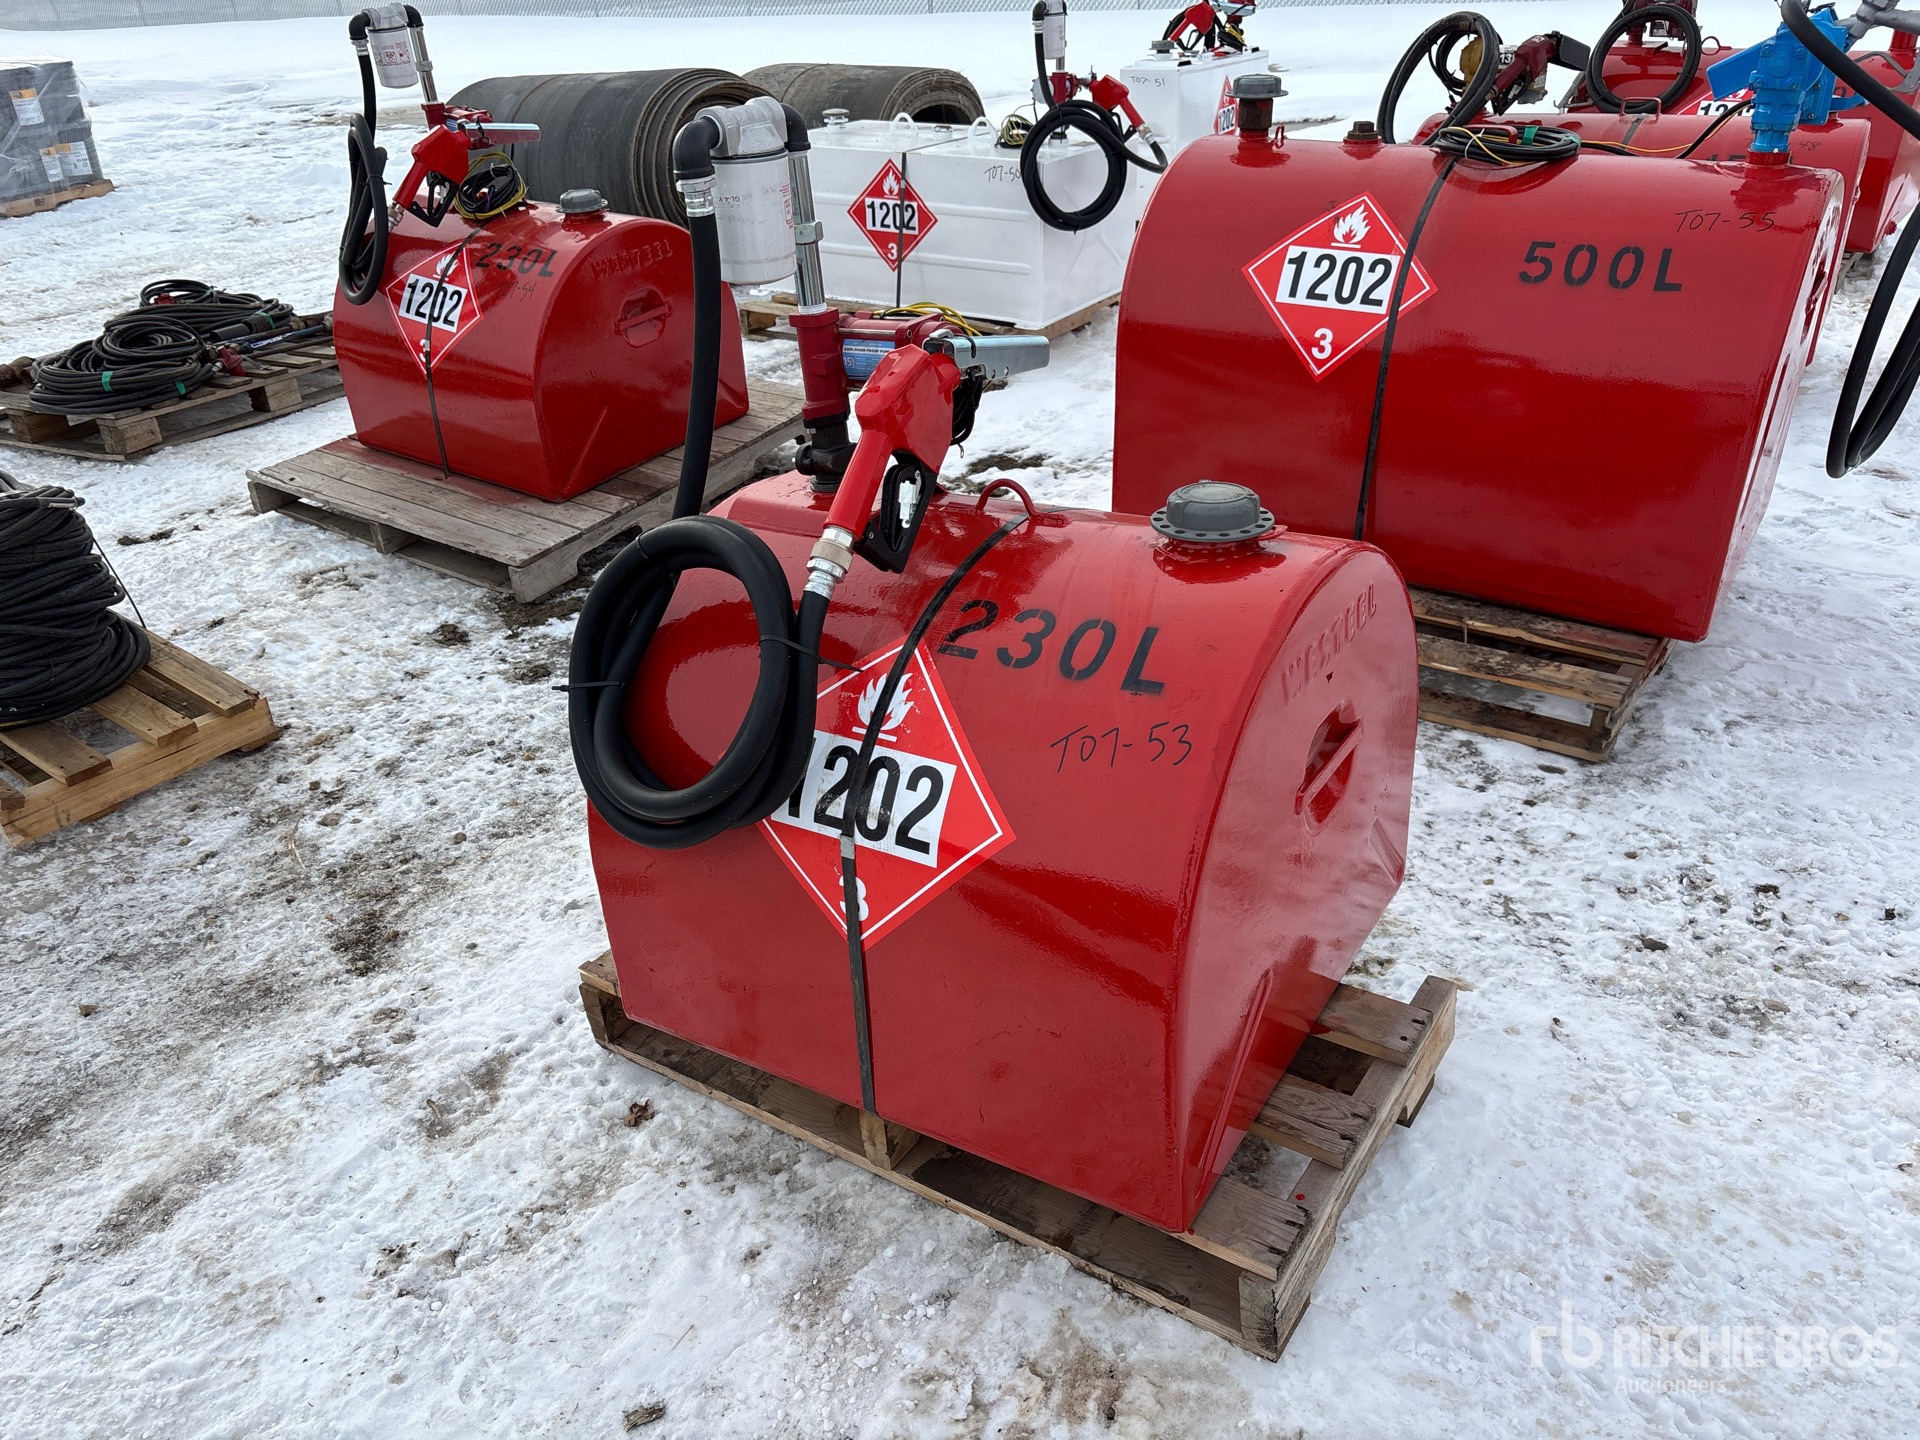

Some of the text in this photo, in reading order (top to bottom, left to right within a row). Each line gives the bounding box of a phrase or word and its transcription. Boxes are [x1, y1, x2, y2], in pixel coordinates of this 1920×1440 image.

[1129, 76, 1165, 87] T07-51
[867, 200, 917, 232] 1202
[1675, 209, 1777, 233] T07-55
[475, 242, 559, 278] 230L
[887, 242, 898, 261] 3
[1519, 241, 1683, 292] 500L
[1287, 250, 1393, 307] 1202
[407, 278, 463, 328] 1202
[1311, 327, 1334, 360] 3
[937, 599, 1165, 695] 230L
[1050, 721, 1193, 774] T07-53
